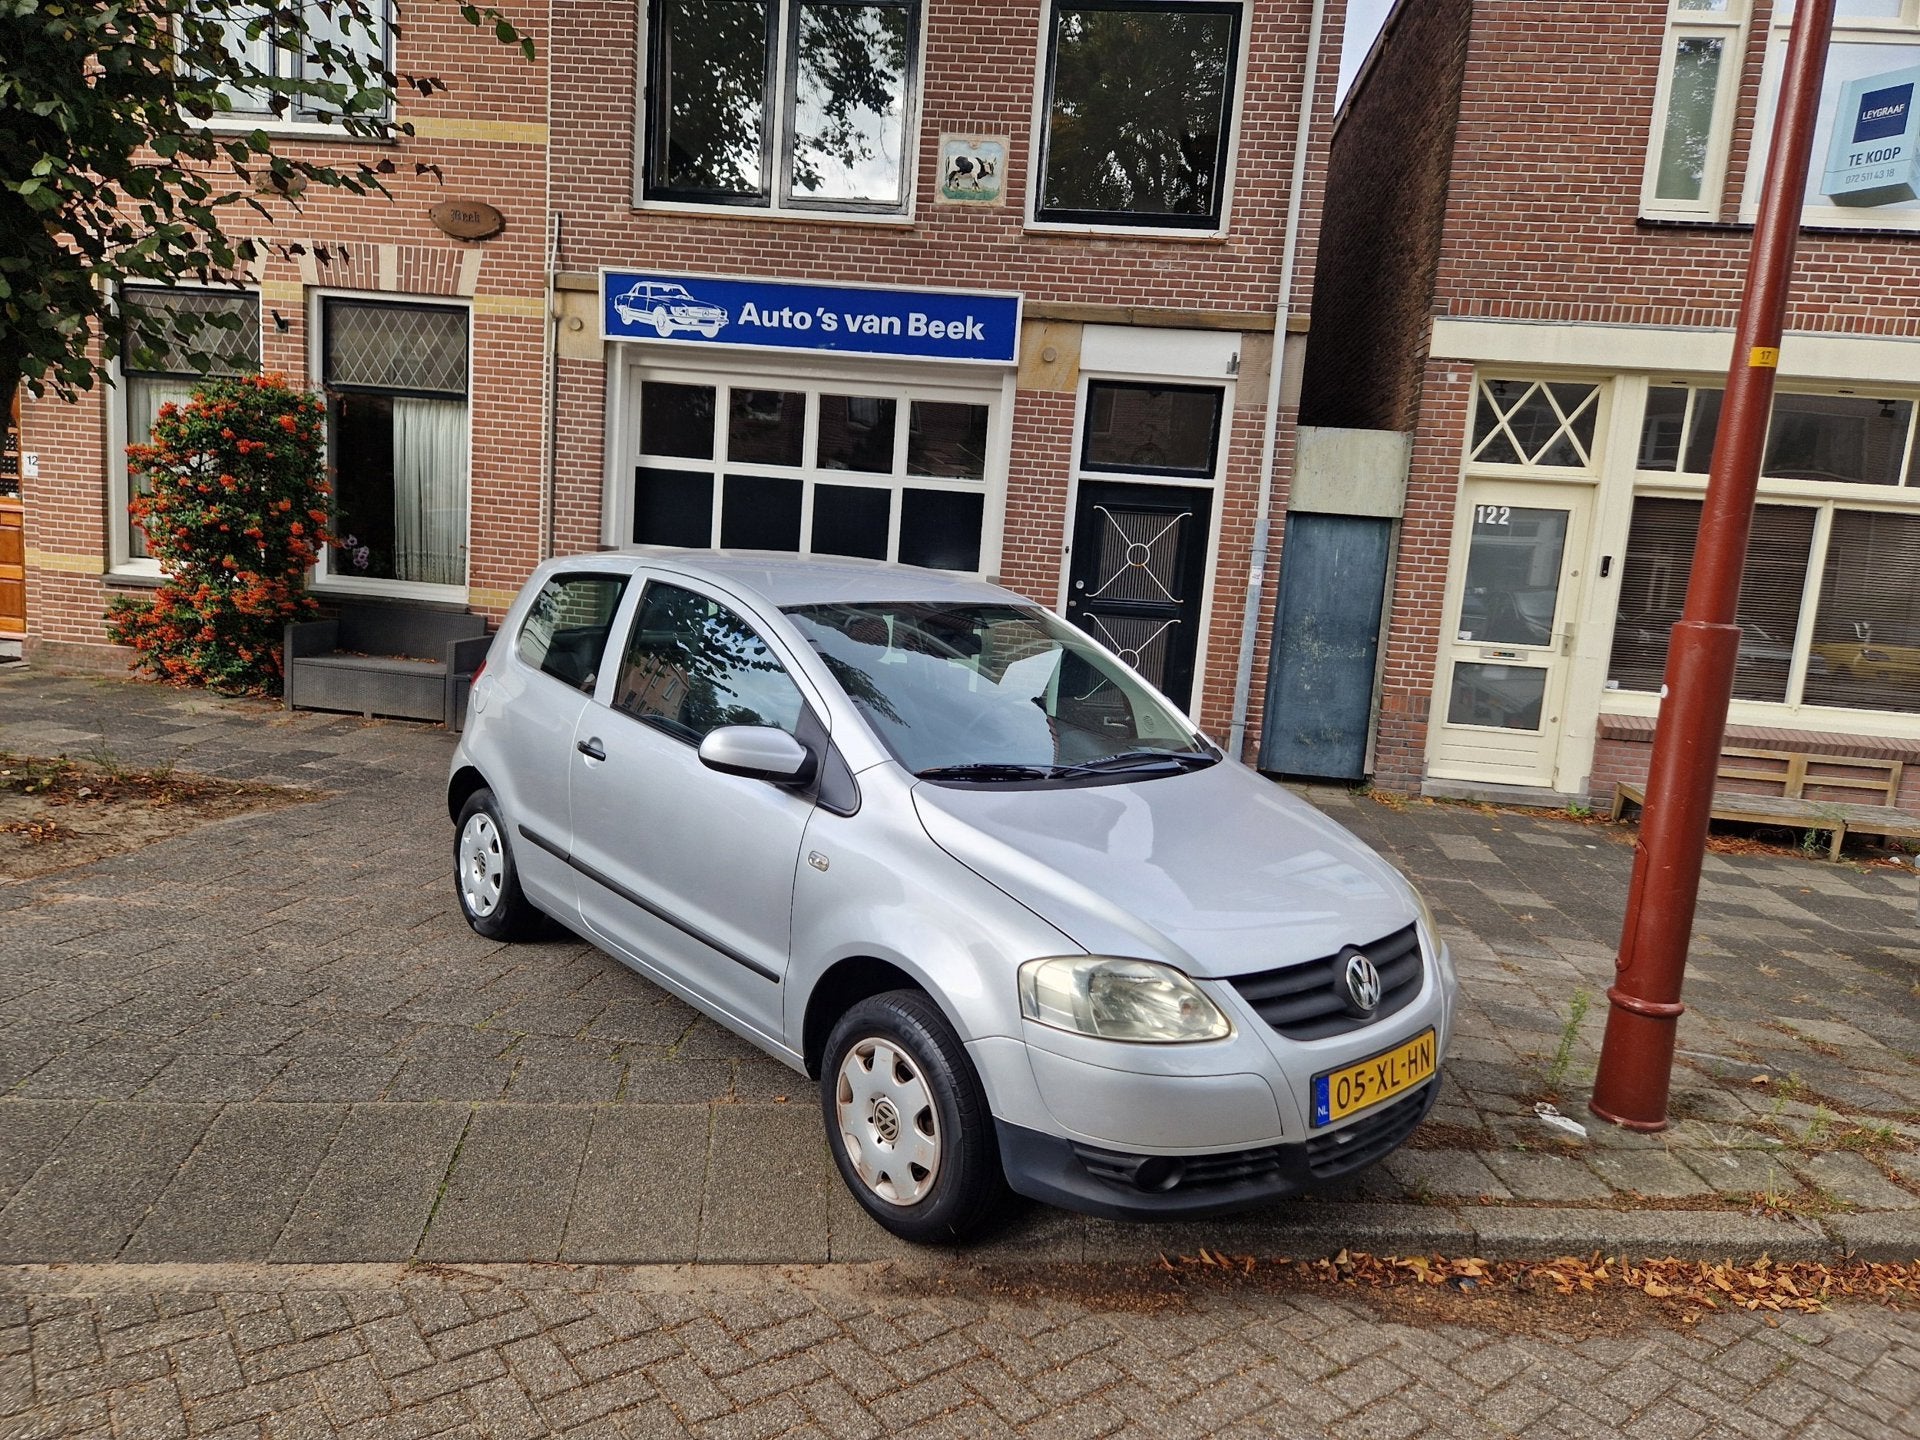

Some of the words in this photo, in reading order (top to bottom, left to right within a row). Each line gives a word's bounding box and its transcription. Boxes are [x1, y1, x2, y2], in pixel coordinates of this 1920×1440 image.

[1862, 103, 1905, 120] LEYGRAAF
[1849, 153, 1863, 167] TE
[1865, 146, 1901, 164] KOOP
[1845, 174, 1861, 184] 072
[1861, 172, 1873, 182] 511
[1873, 170, 1884, 180] 43
[1886, 168, 1895, 178] 18
[737, 302, 839, 332] Auto's
[844, 313, 901, 336] van
[907, 312, 986, 341] Beek
[1760, 350, 1772, 361] 17
[1477, 505, 1511, 525] 122
[1336, 1039, 1431, 1110] 05-XL-HN
[1317, 1105, 1328, 1117] NL
